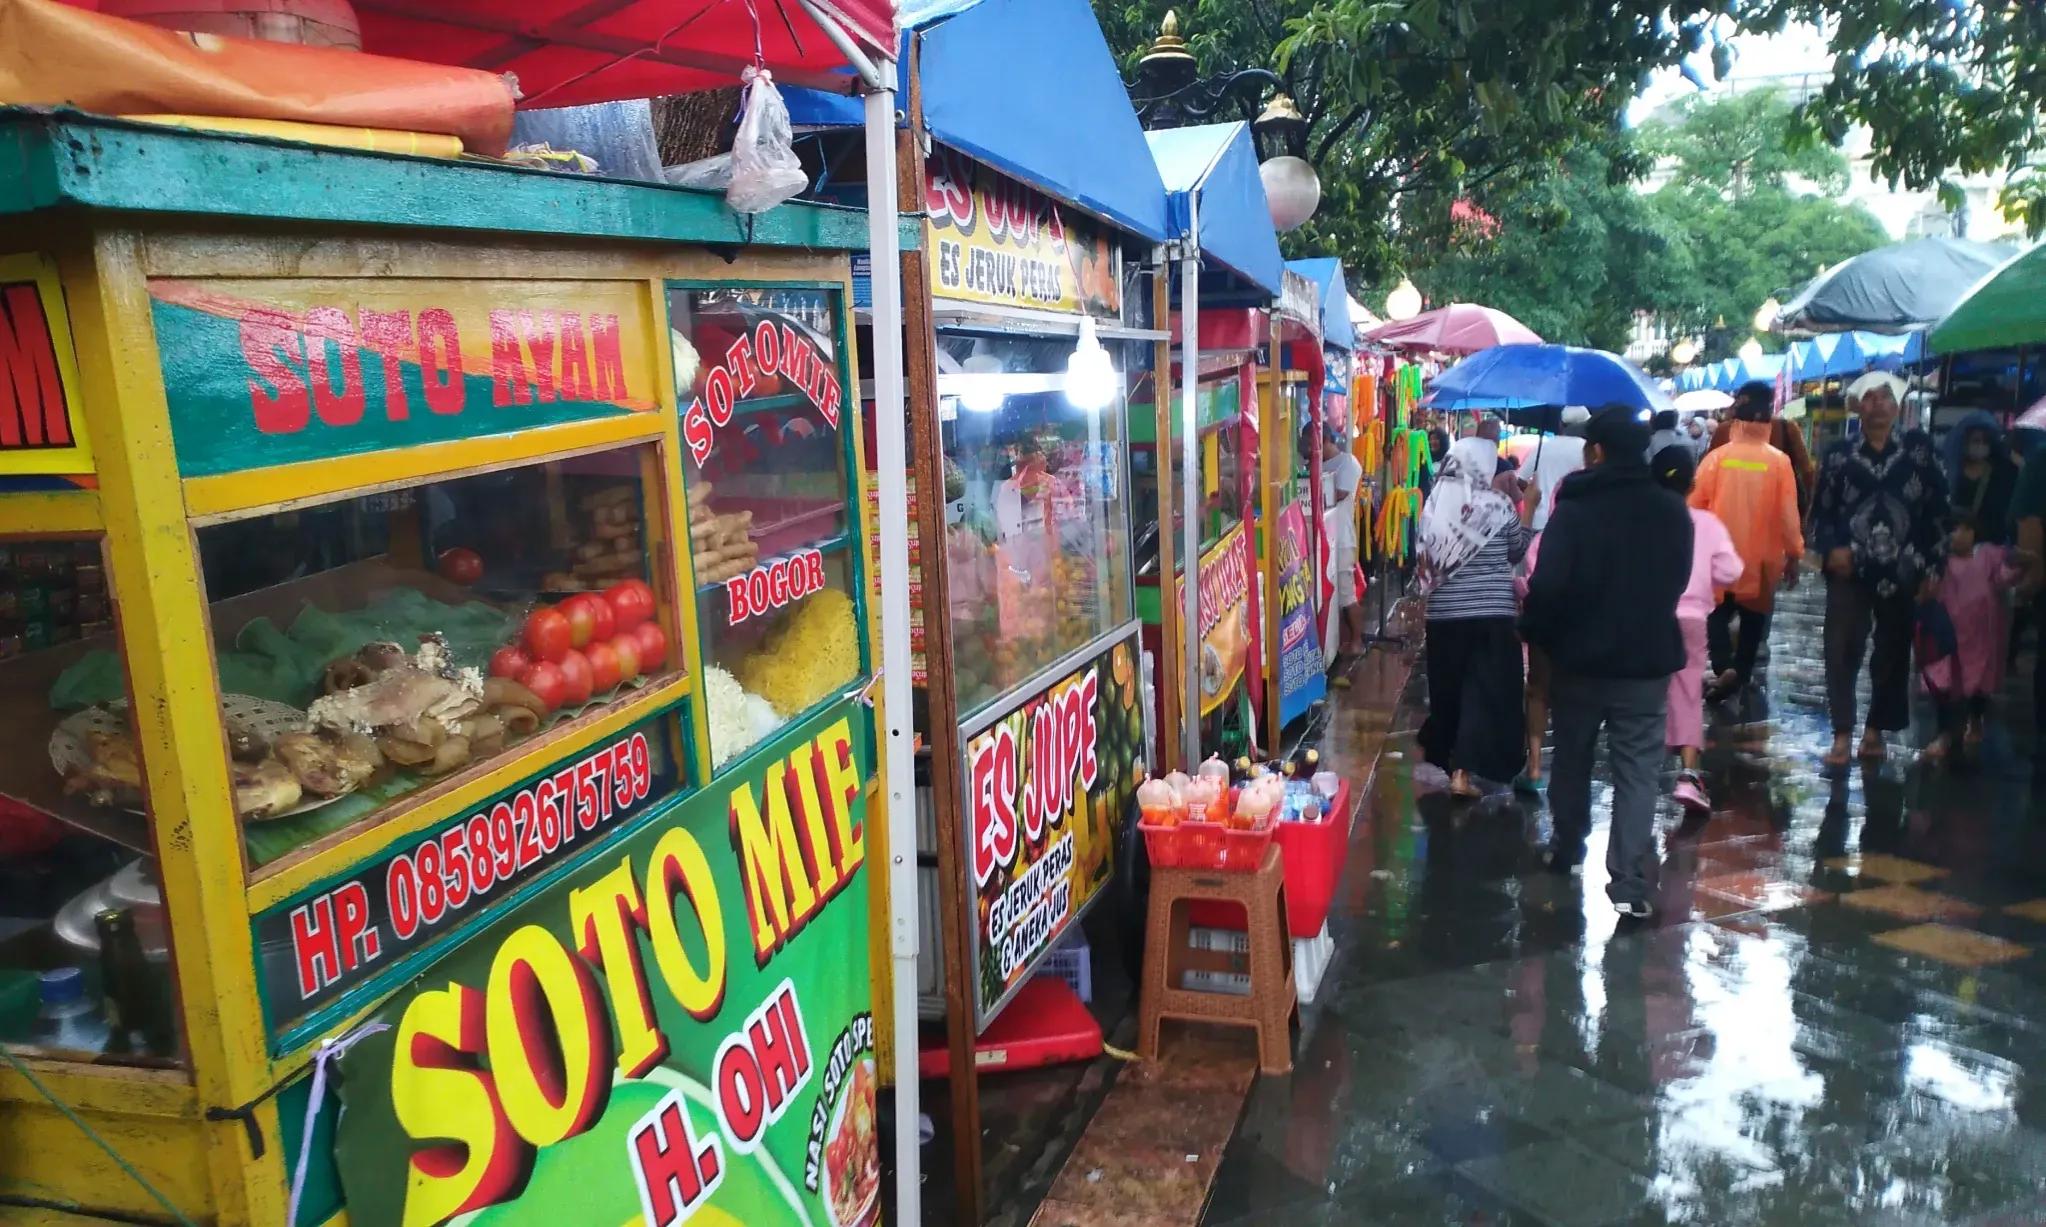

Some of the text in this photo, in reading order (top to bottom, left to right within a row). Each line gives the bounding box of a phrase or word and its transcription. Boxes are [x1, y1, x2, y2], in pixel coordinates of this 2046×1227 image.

[939, 239, 1062, 303] ES JERUK PERAS
[239, 305, 628, 434] SOTO AYAM
[728, 548, 825, 626] BOGOR
[972, 668, 1097, 888] ES JUPE
[290, 731, 652, 1000] HP. 085892675759
[990, 834, 1073, 941] ES JERUK PERAS
[1002, 880, 1069, 975] & ANEKA JUS
[391, 717, 865, 1227] SOTO MIE
[629, 979, 812, 1227] H. OHI
[804, 1098, 829, 1193] NASI
[823, 1028, 852, 1107] SOTO
